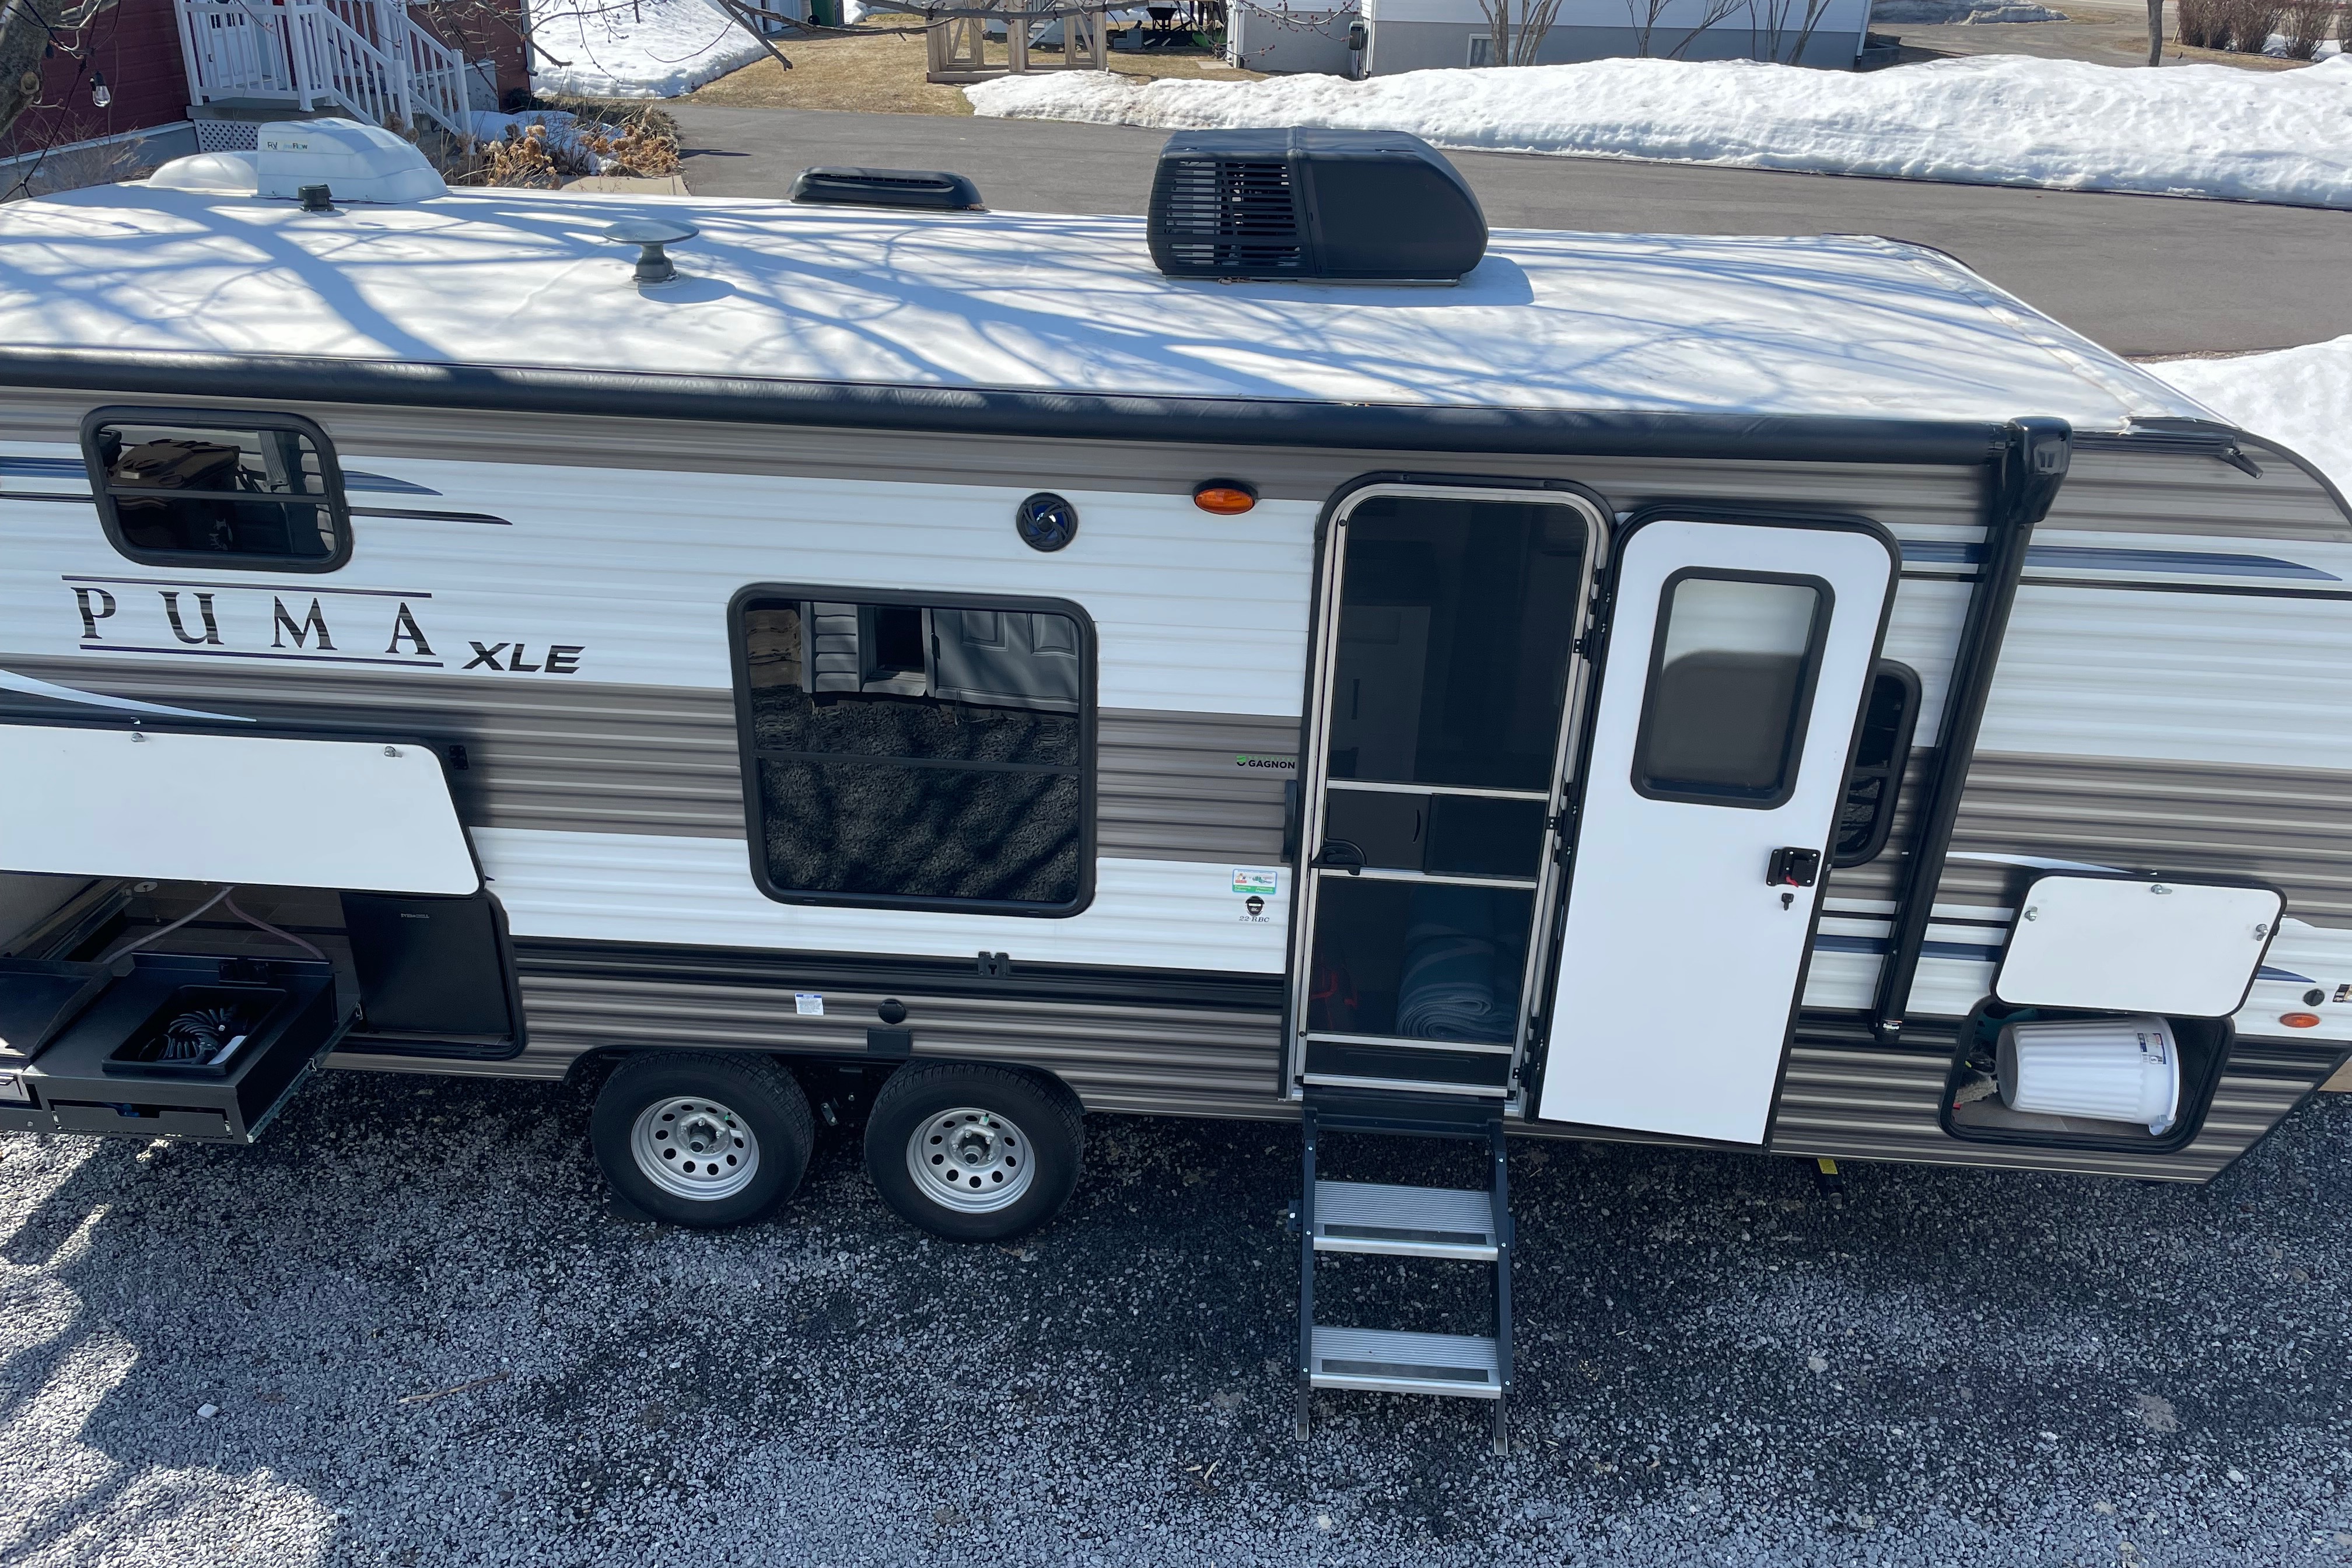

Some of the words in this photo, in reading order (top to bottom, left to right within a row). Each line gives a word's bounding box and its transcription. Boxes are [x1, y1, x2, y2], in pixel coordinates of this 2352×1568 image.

[70, 586, 437, 656] PUMA
[462, 641, 586, 674] XLE
[1248, 760, 1296, 769] GAGNON
